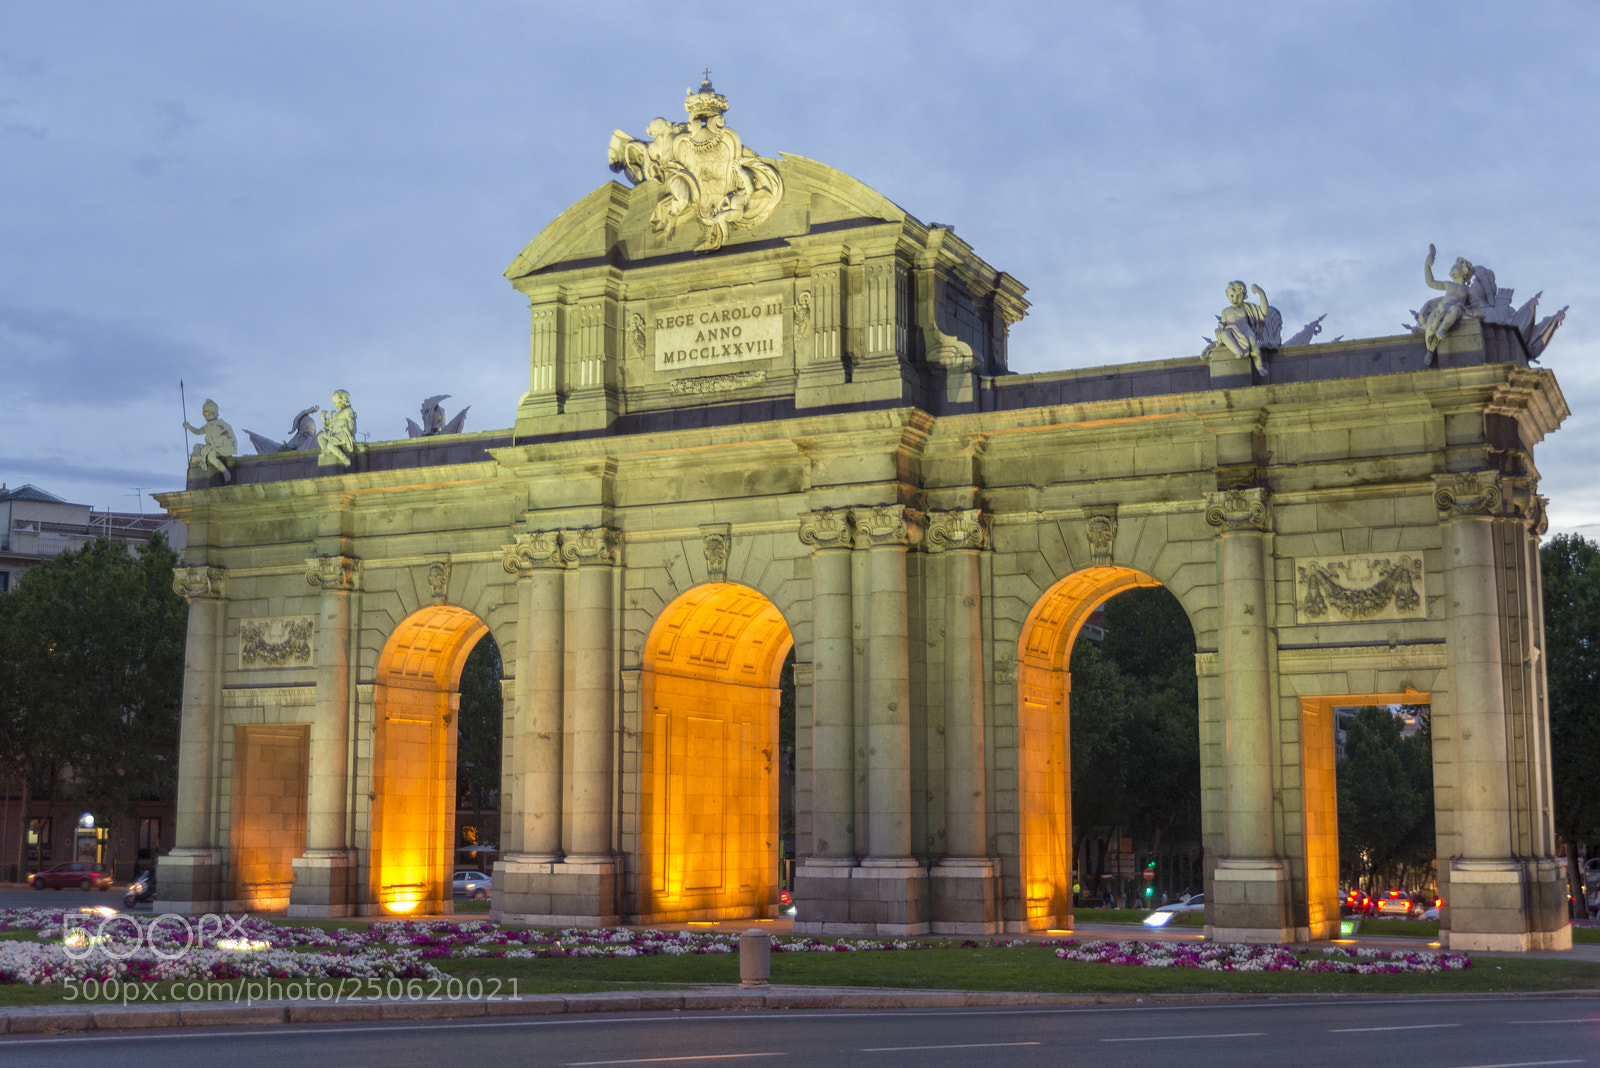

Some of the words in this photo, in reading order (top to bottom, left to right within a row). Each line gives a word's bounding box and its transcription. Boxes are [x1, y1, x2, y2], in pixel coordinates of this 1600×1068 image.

[656, 314, 695, 330] REGE
[699, 306, 762, 324] CAROLO
[766, 303, 783, 316] III
[695, 326, 742, 343] ANNO
[663, 339, 774, 364] MDCCLXXVIII
